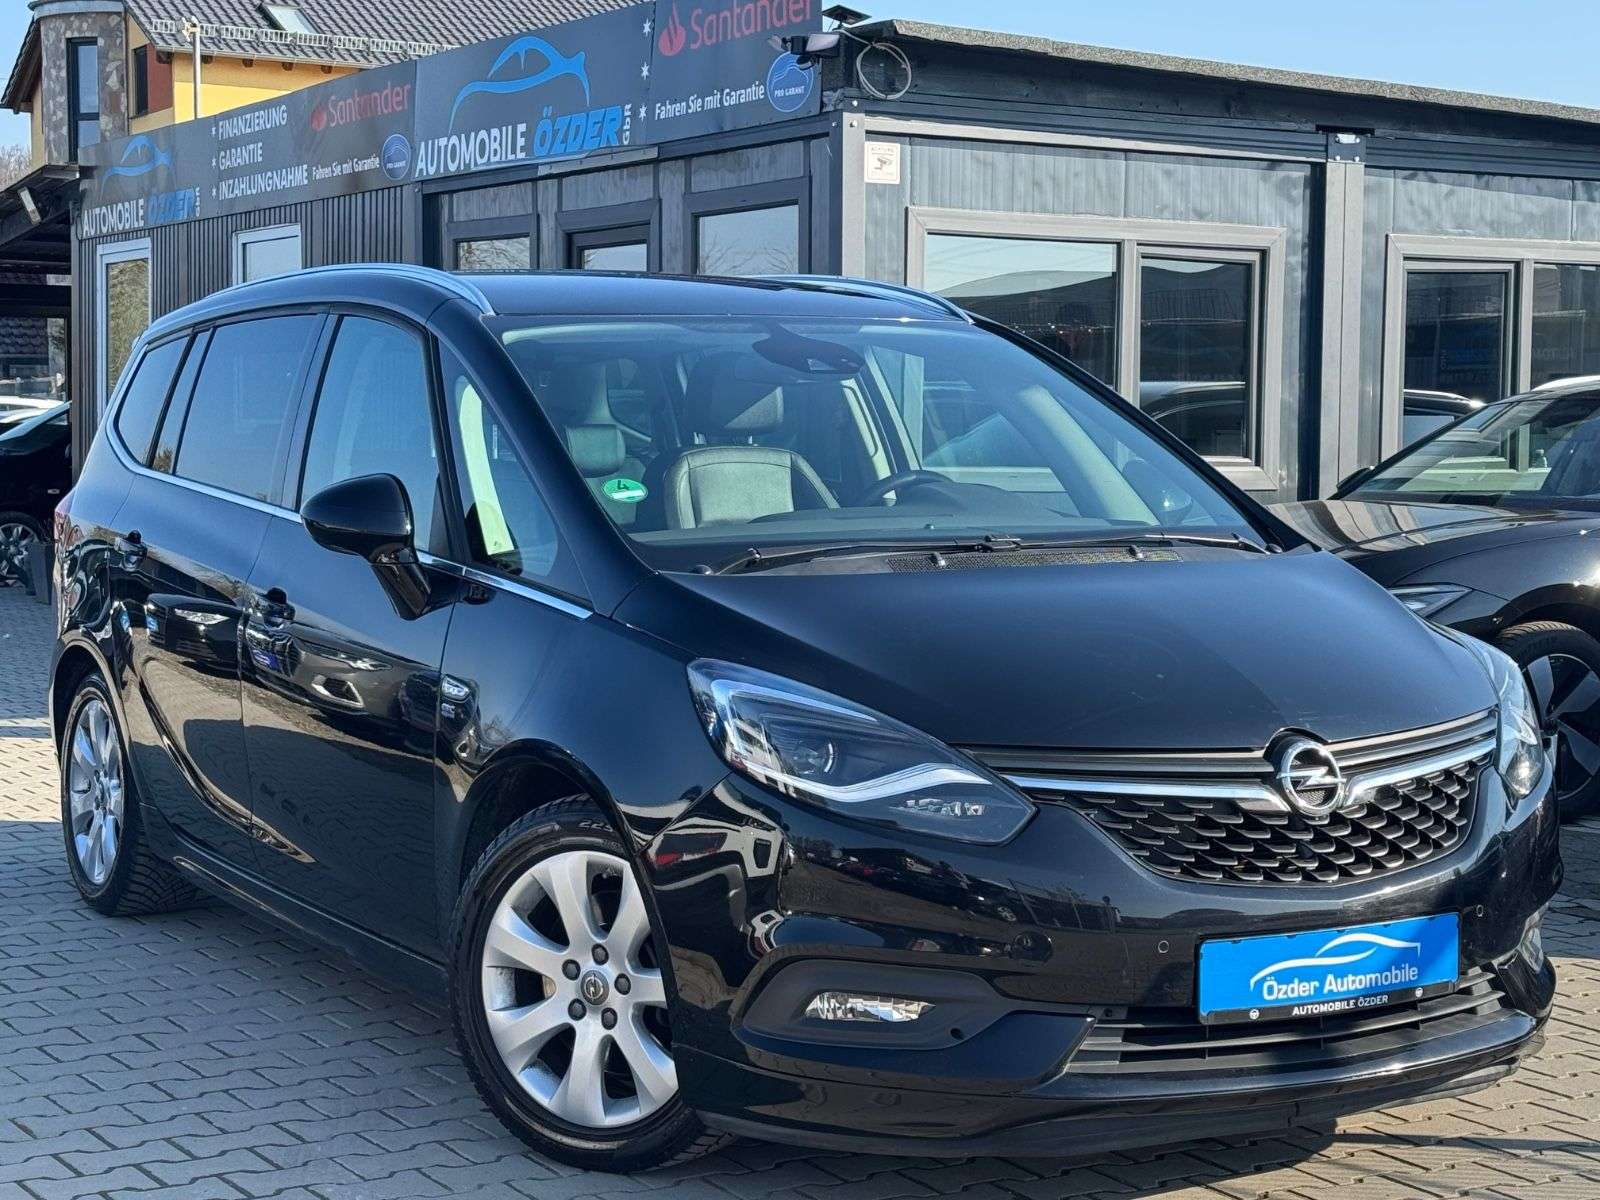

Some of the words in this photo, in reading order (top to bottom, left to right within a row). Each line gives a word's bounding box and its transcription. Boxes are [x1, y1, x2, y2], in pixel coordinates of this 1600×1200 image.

[690, 0, 811, 49] Santander
[327, 81, 411, 127] Santander
[655, 99, 687, 120] Fahren
[688, 94, 702, 114] Sie
[704, 89, 720, 111] mit
[722, 80, 765, 107] Garantie
[774, 89, 784, 98] PRO
[785, 86, 805, 95] GARANT
[218, 104, 288, 140] FINANZIERUNG
[219, 142, 263, 170] GARANTIE
[415, 122, 527, 178] AUTOMOBILE
[534, 105, 625, 157] ÖZDER
[622, 103, 633, 145] GbR
[219, 164, 308, 200] INZAHLUNGNAHME
[332, 161, 342, 176] Sie
[82, 198, 144, 238] AUTOMOBILE
[1262, 976, 1319, 1000] Özder
[1323, 963, 1418, 994] Automobile
[1292, 1000, 1355, 1016] AUTOMOBILE
[1357, 994, 1388, 1007] ÖZDER
